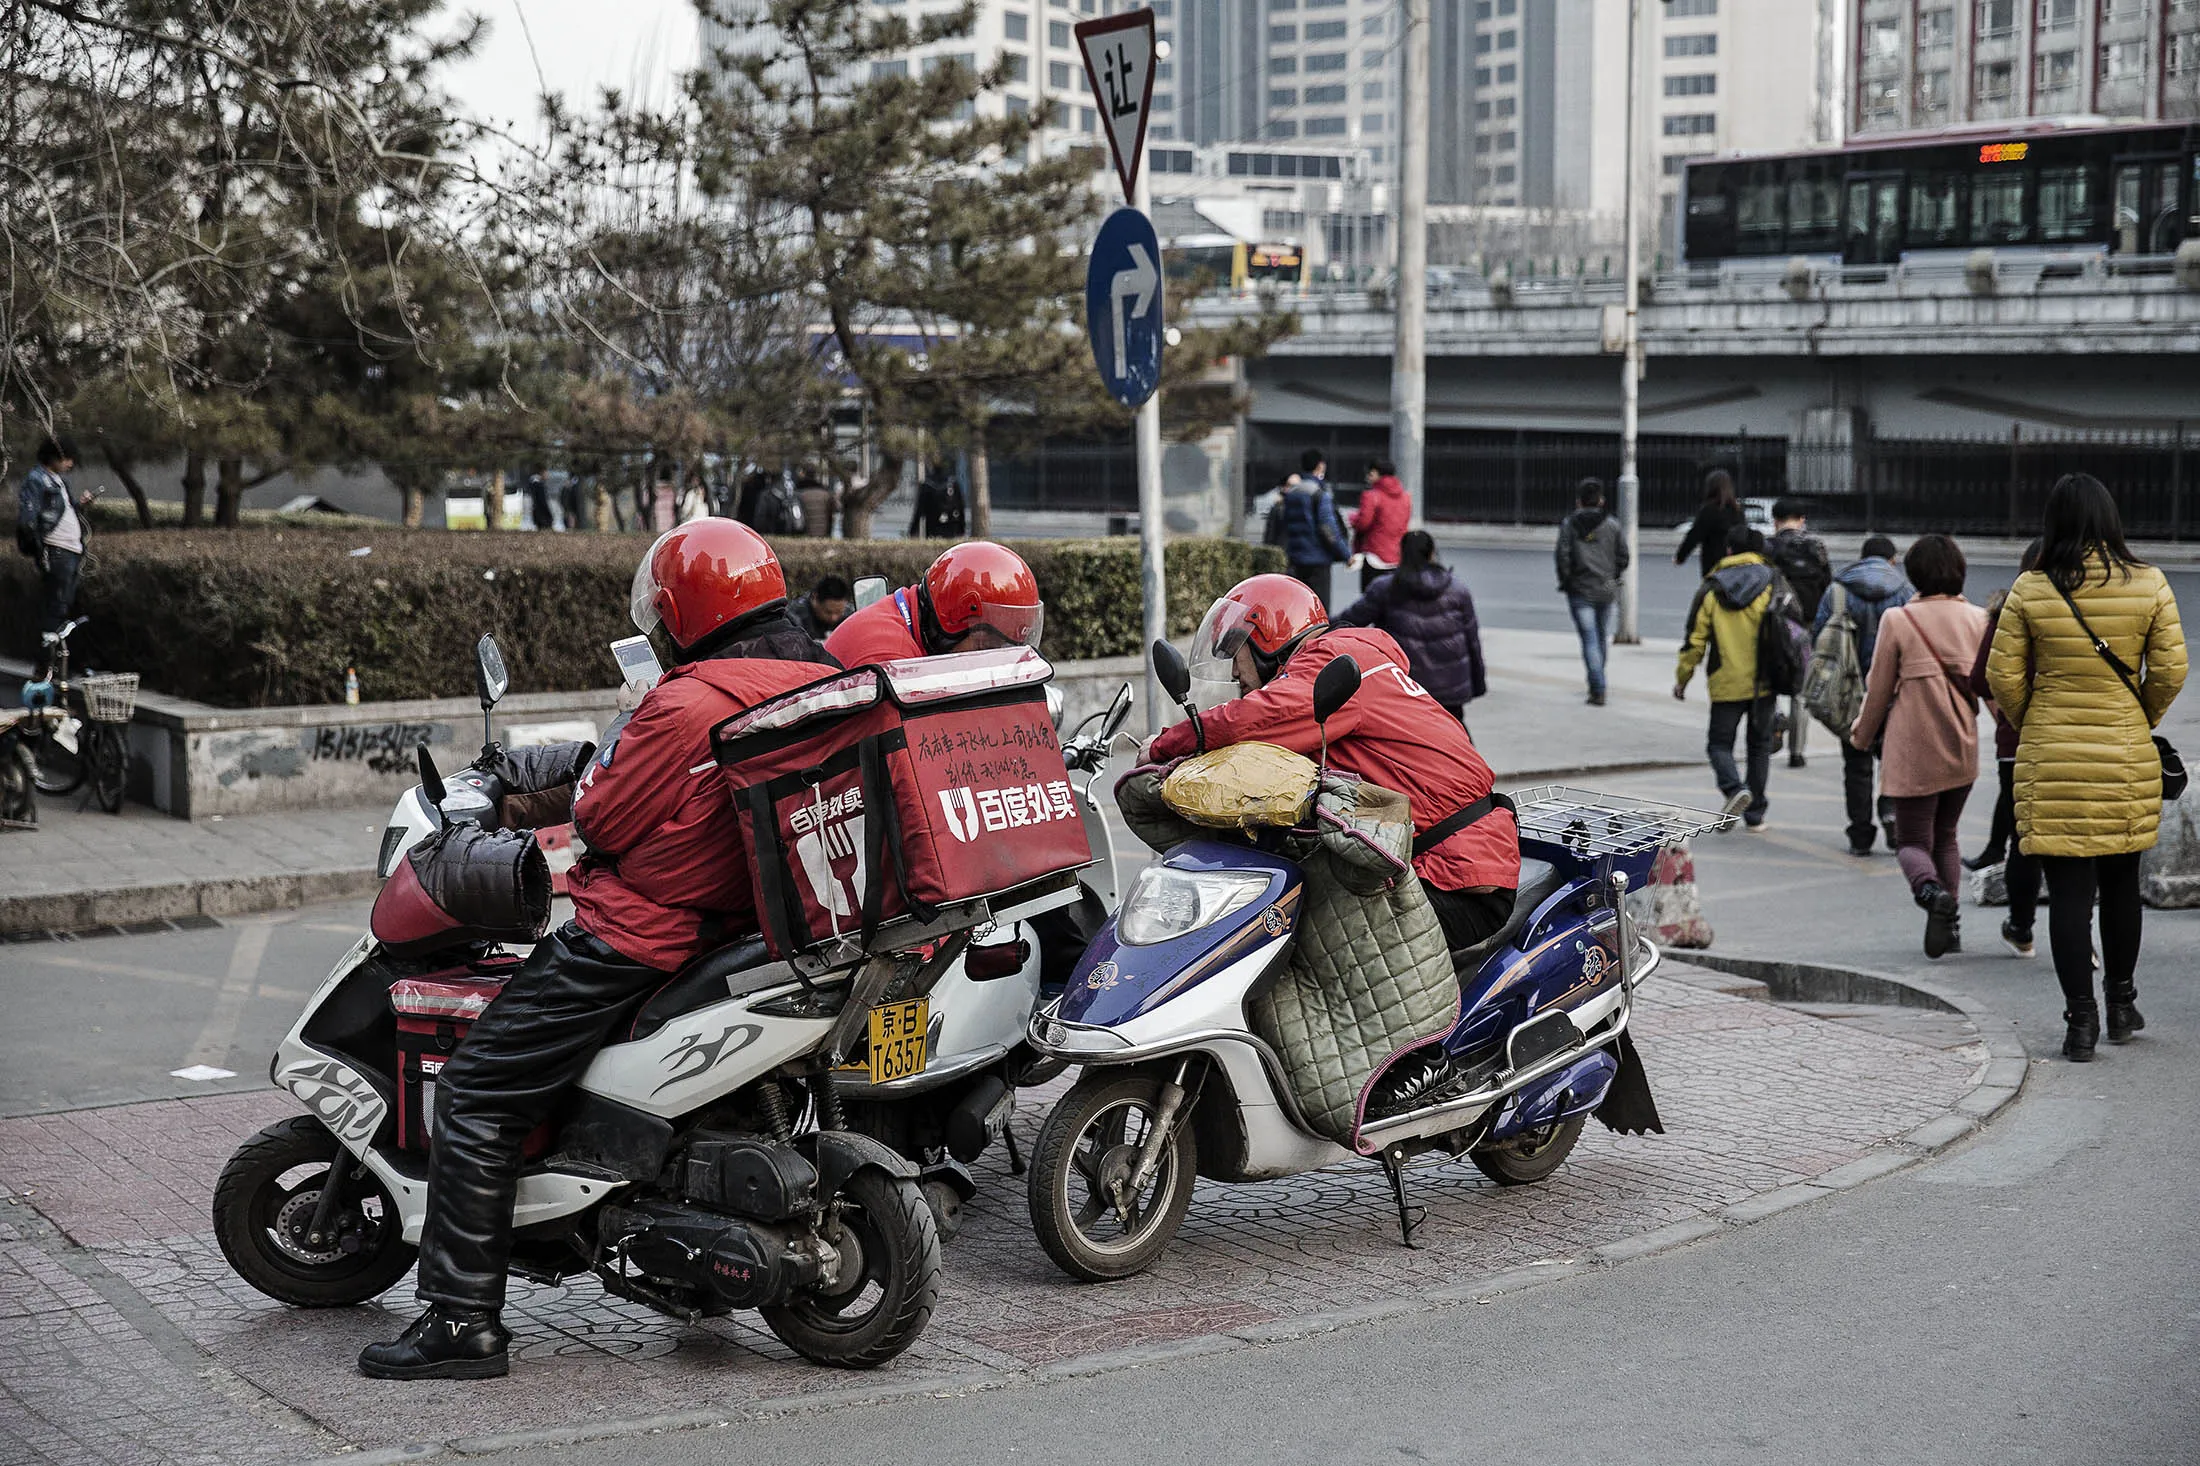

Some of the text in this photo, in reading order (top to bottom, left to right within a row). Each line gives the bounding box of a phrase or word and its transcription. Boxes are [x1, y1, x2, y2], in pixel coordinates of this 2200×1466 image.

[1103, 42, 1138, 120] 让
[789, 786, 865, 834] 百度外卖
[976, 779, 1077, 832] 百度外卖
[873, 1035, 925, 1081] T6357
